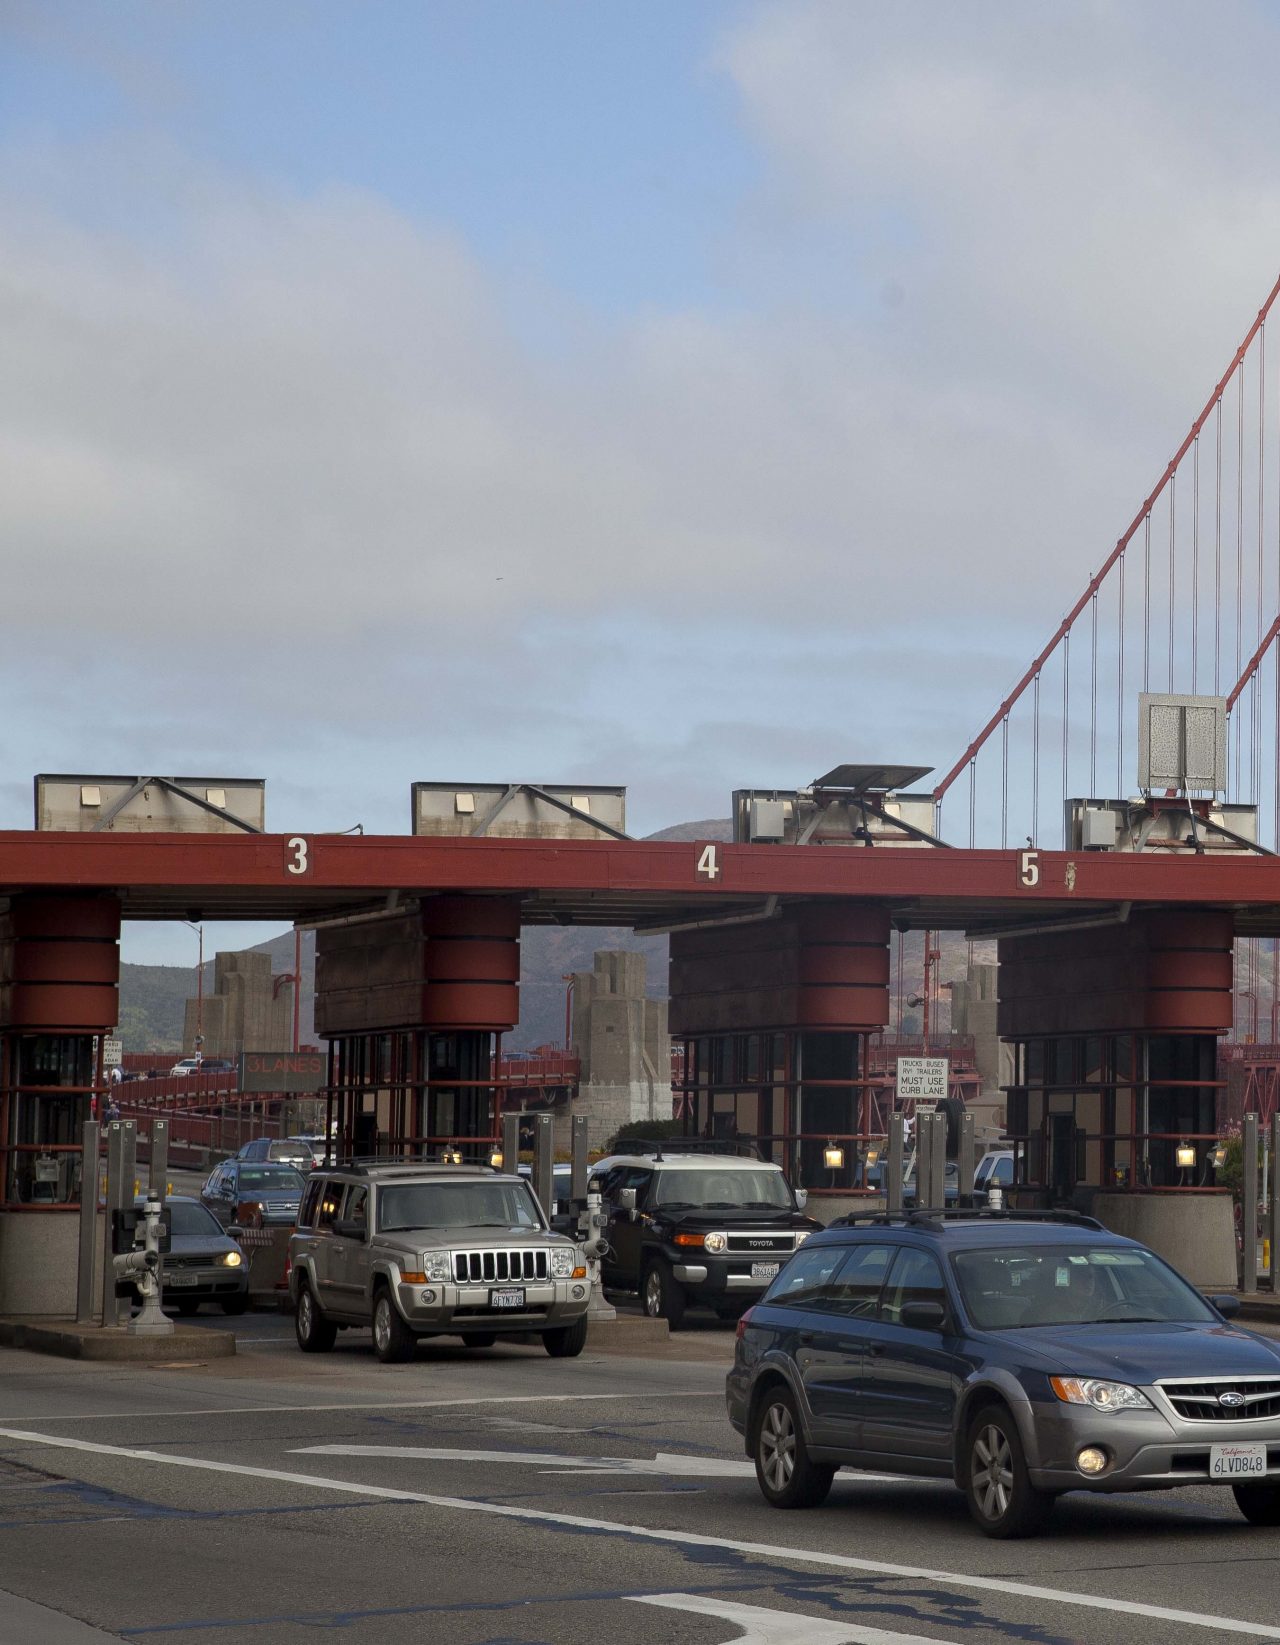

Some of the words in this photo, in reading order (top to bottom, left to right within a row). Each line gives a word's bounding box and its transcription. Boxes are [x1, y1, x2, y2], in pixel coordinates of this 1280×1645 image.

[288, 837, 307, 874] 3
[697, 845, 719, 879] 4
[1022, 852, 1039, 886] 5
[901, 1077, 923, 1085] MUST
[927, 1077, 944, 1085] USE
[923, 1087, 944, 1095] LANE
[1221, 1448, 1255, 1456] California
[1214, 1457, 1263, 1473] 6LVD848
